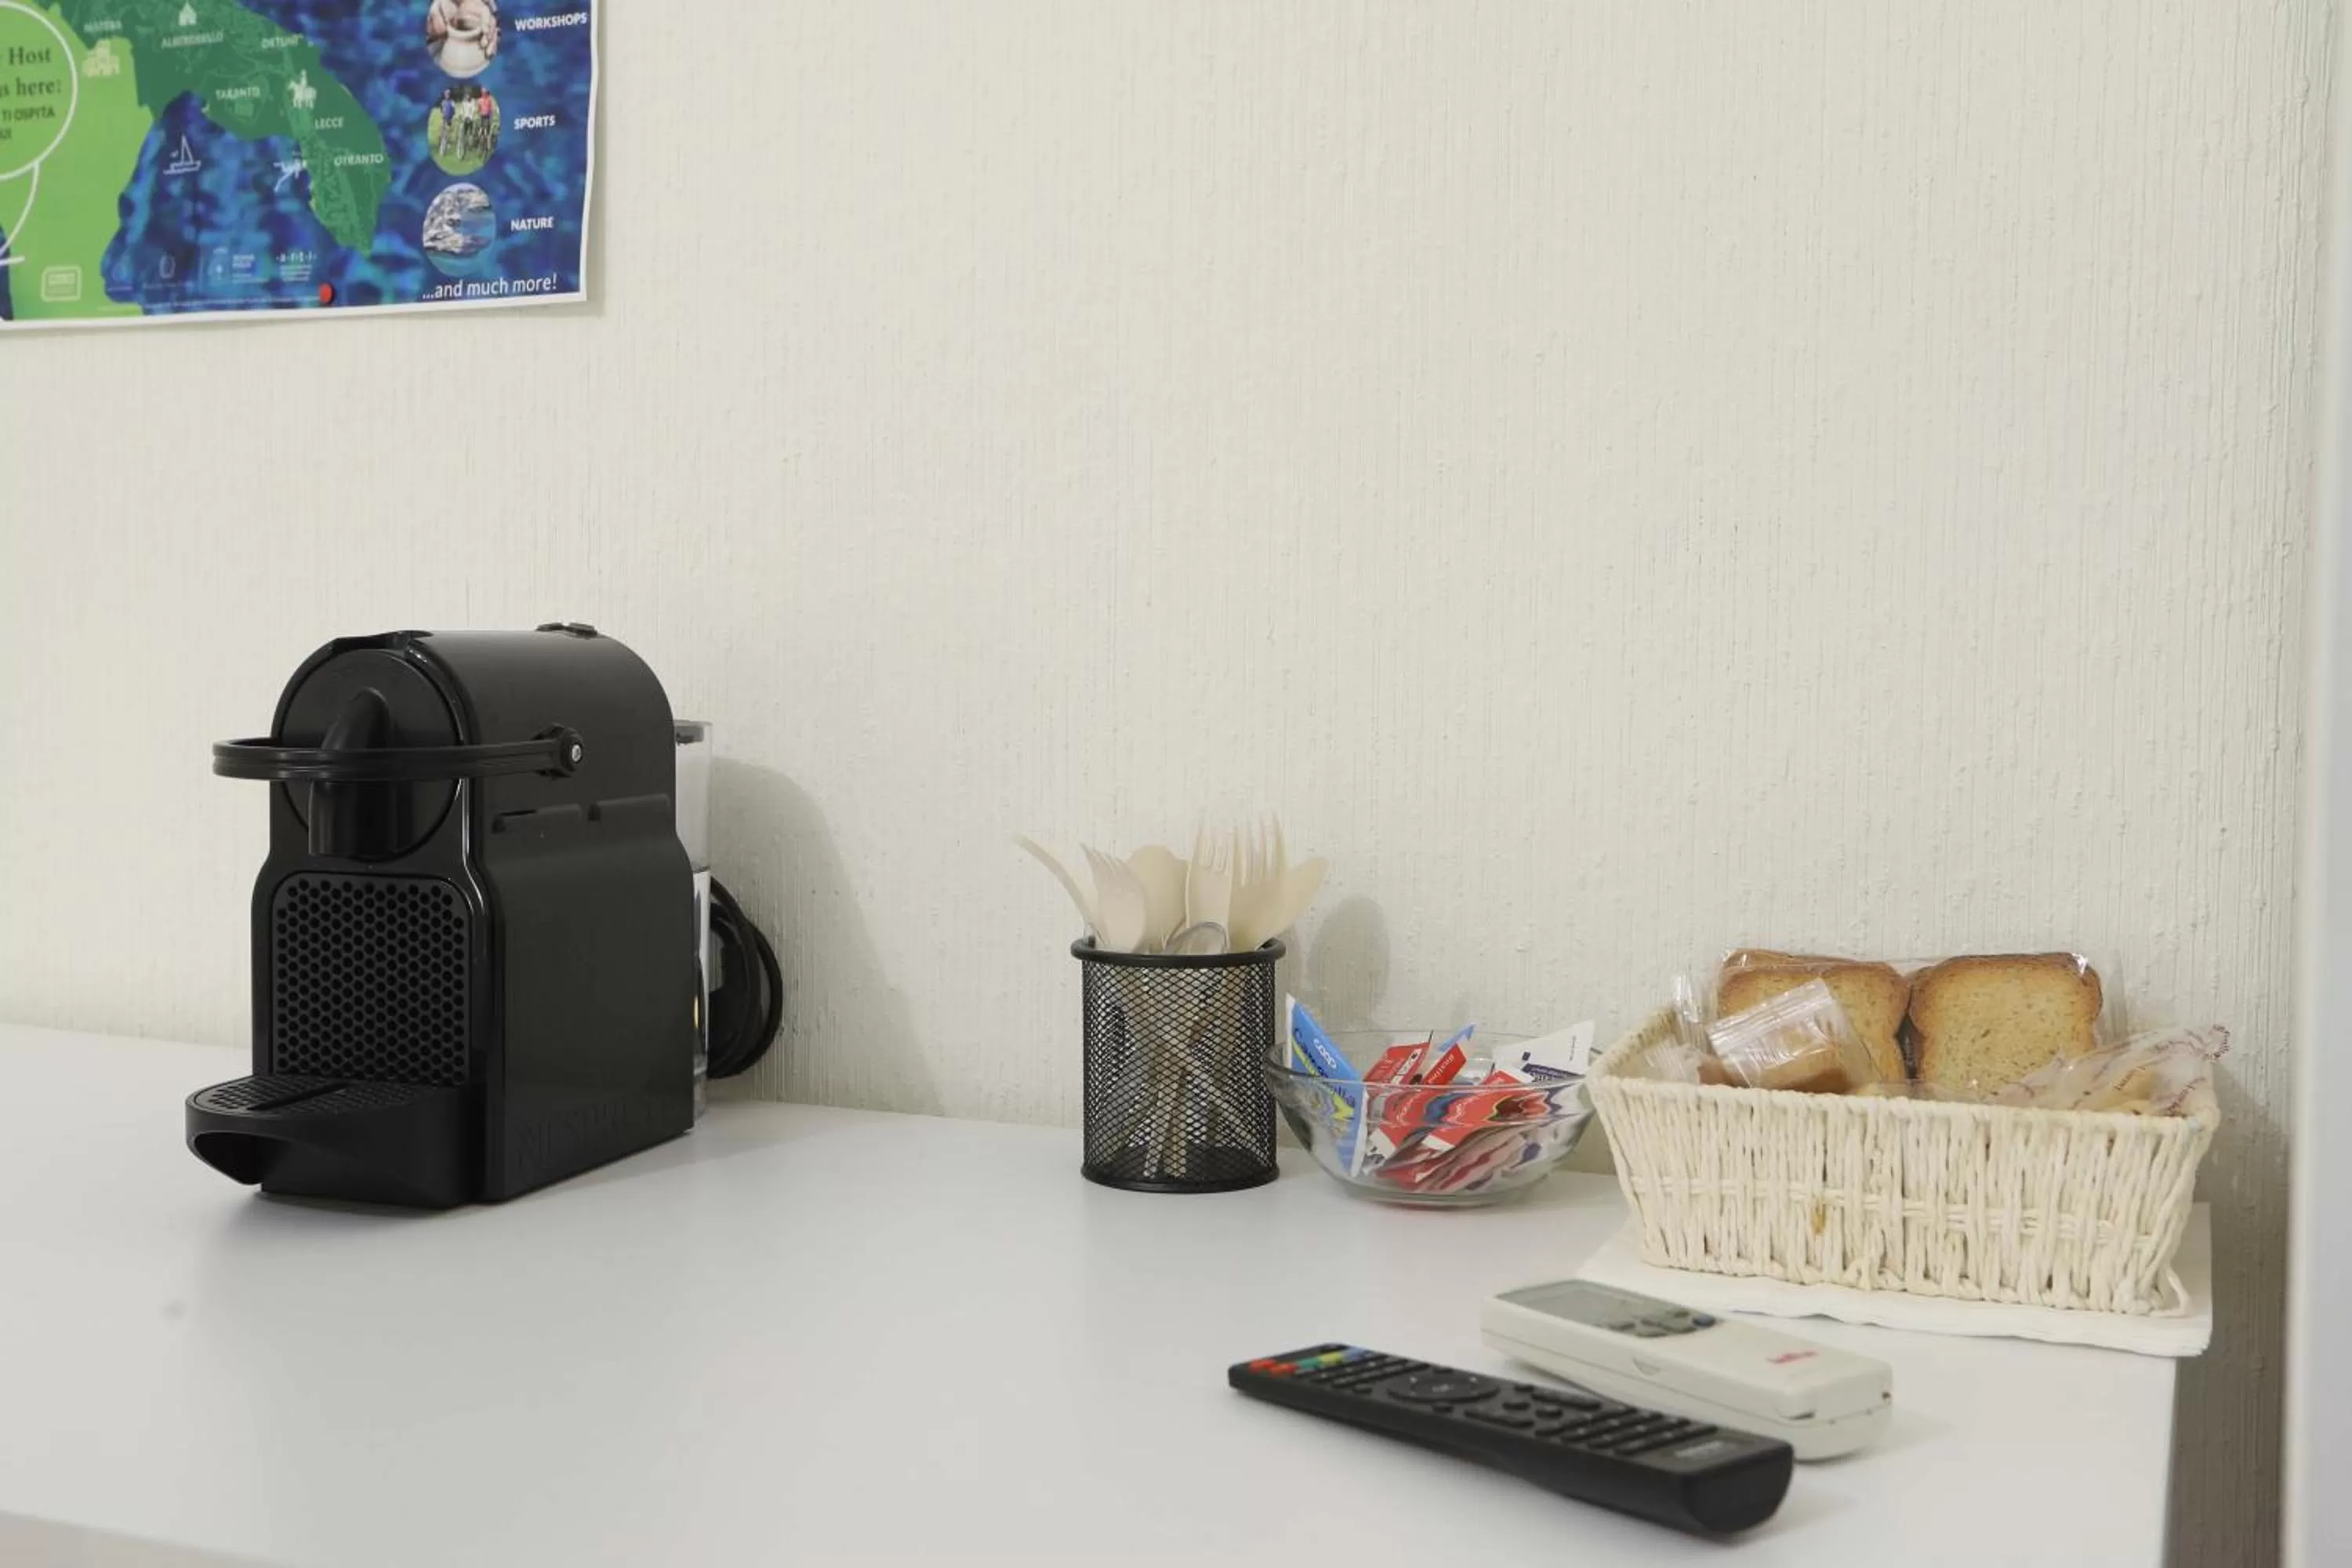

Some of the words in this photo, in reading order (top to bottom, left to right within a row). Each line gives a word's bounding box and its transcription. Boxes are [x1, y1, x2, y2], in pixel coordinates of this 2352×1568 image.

[514, 13, 588, 31] WORKSHOPS
[9, 46, 51, 65] Host
[16, 77, 62, 96] here:
[314, 117, 343, 129] LECCE
[514, 115, 555, 129] SPORTS
[510, 216, 554, 230] NATURE
[423, 279, 463, 299] ...and
[466, 277, 509, 296] much
[512, 272, 557, 292] more!
